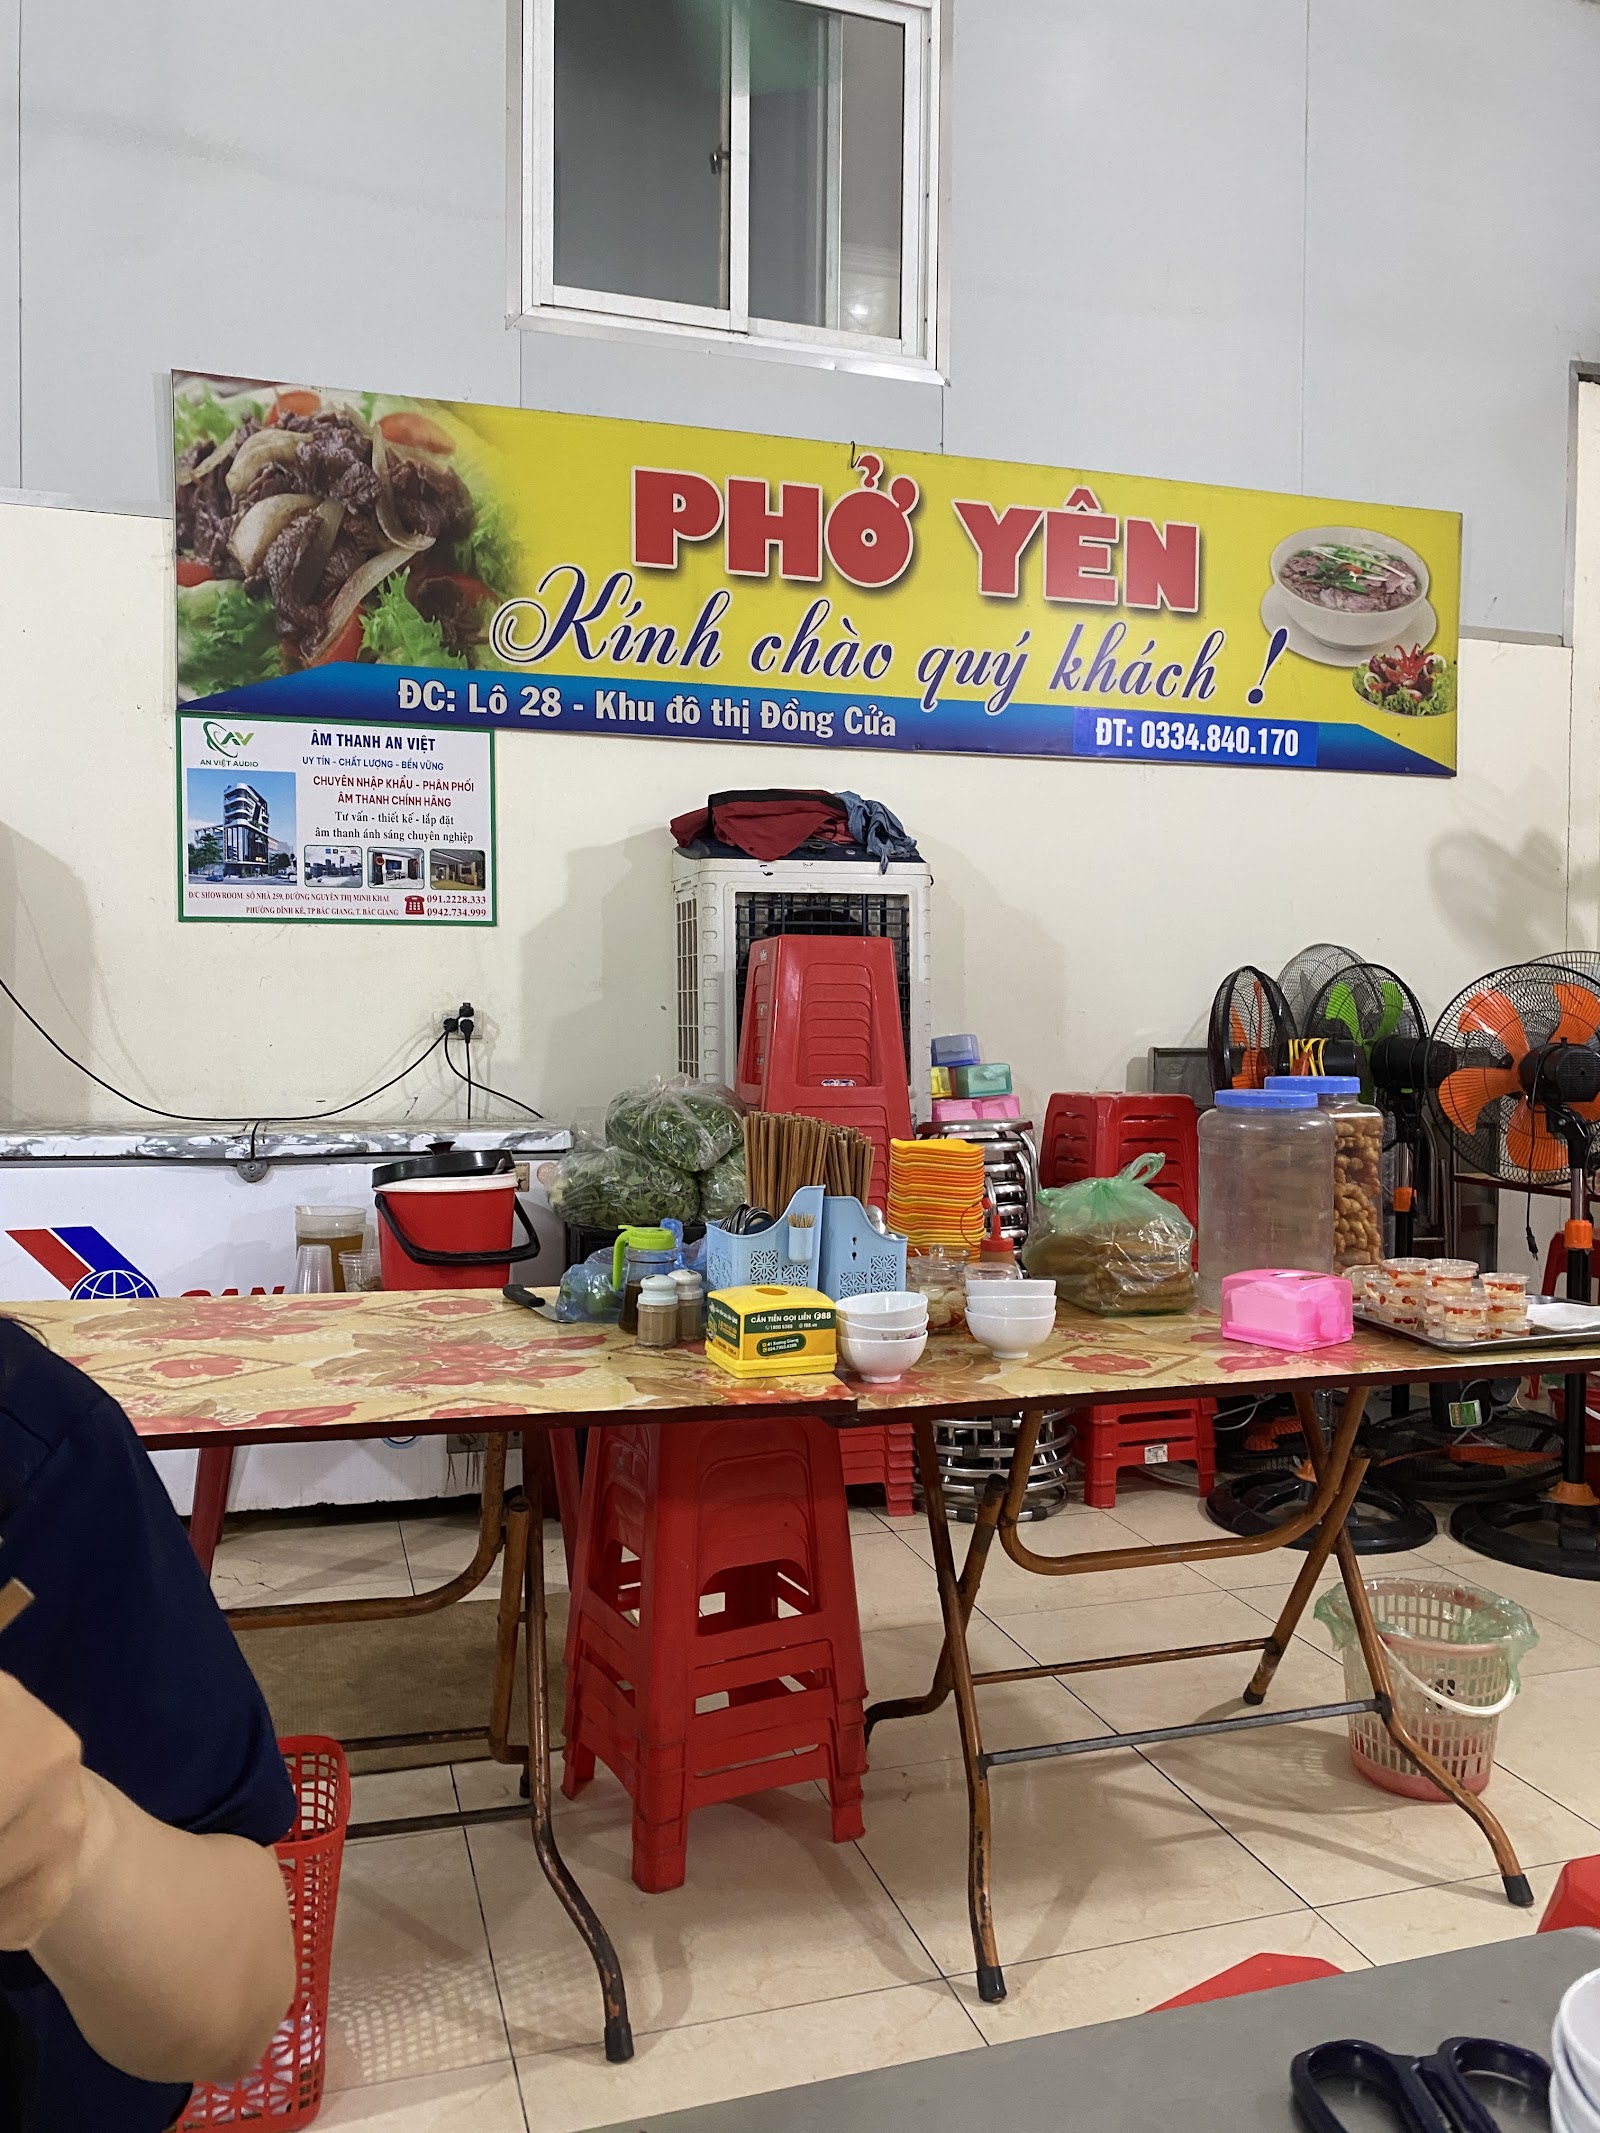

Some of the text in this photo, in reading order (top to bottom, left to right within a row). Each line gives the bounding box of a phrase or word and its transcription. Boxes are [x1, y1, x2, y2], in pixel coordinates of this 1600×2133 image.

[632, 453, 1200, 612] PHỞ YÊN
[491, 564, 730, 667] Kính
[750, 598, 894, 680] chào
[917, 630, 1031, 714] quý
[1049, 622, 1225, 701] khách
[398, 678, 456, 712] ĐC:
[469, 683, 508, 716] Lô
[519, 686, 562, 718] 28
[595, 690, 655, 724] Khu
[666, 694, 701, 727] đô
[711, 695, 749, 735] thị
[760, 697, 834, 739] Đồng
[844, 702, 897, 738] Cửa
[311, 729, 436, 753] ÂM THANH AN VIỆT
[1095, 717, 1299, 757] ĐT: 0334.840.170
[213, 758, 231, 768] VIỆT
[302, 756, 314, 765] UY
[317, 755, 331, 766] TÍN
[338, 755, 362, 768] CHẤT
[363, 757, 394, 770] LƯỢNG
[401, 758, 418, 770] BỀN
[420, 760, 444, 771] VỮNG
[313, 774, 354, 787] CHUYÊN
[356, 775, 384, 792] NHẬP
[385, 774, 413, 790] KHẨU
[422, 779, 450, 792] PHÂN
[451, 778, 474, 793] PHỐI
[337, 790, 452, 808] ÂM THANH CHÍNH HÃNG
[335, 810, 349, 822] Tư
[351, 810, 368, 822] vấn
[378, 811, 399, 823] thiết
[402, 811, 415, 824] kế
[422, 814, 437, 827] lắp
[439, 815, 454, 828] đặt
[315, 827, 474, 844] âm thanh ánh sáng chuyên nghiệp
[353, 894, 371, 903] MINH
[372, 895, 390, 903] KHAI
[427, 895, 487, 904] 091.2228.333
[377, 908, 399, 917] GIANG
[427, 908, 487, 917] 0942.734.999
[783, 1313, 797, 1324] GỌI
